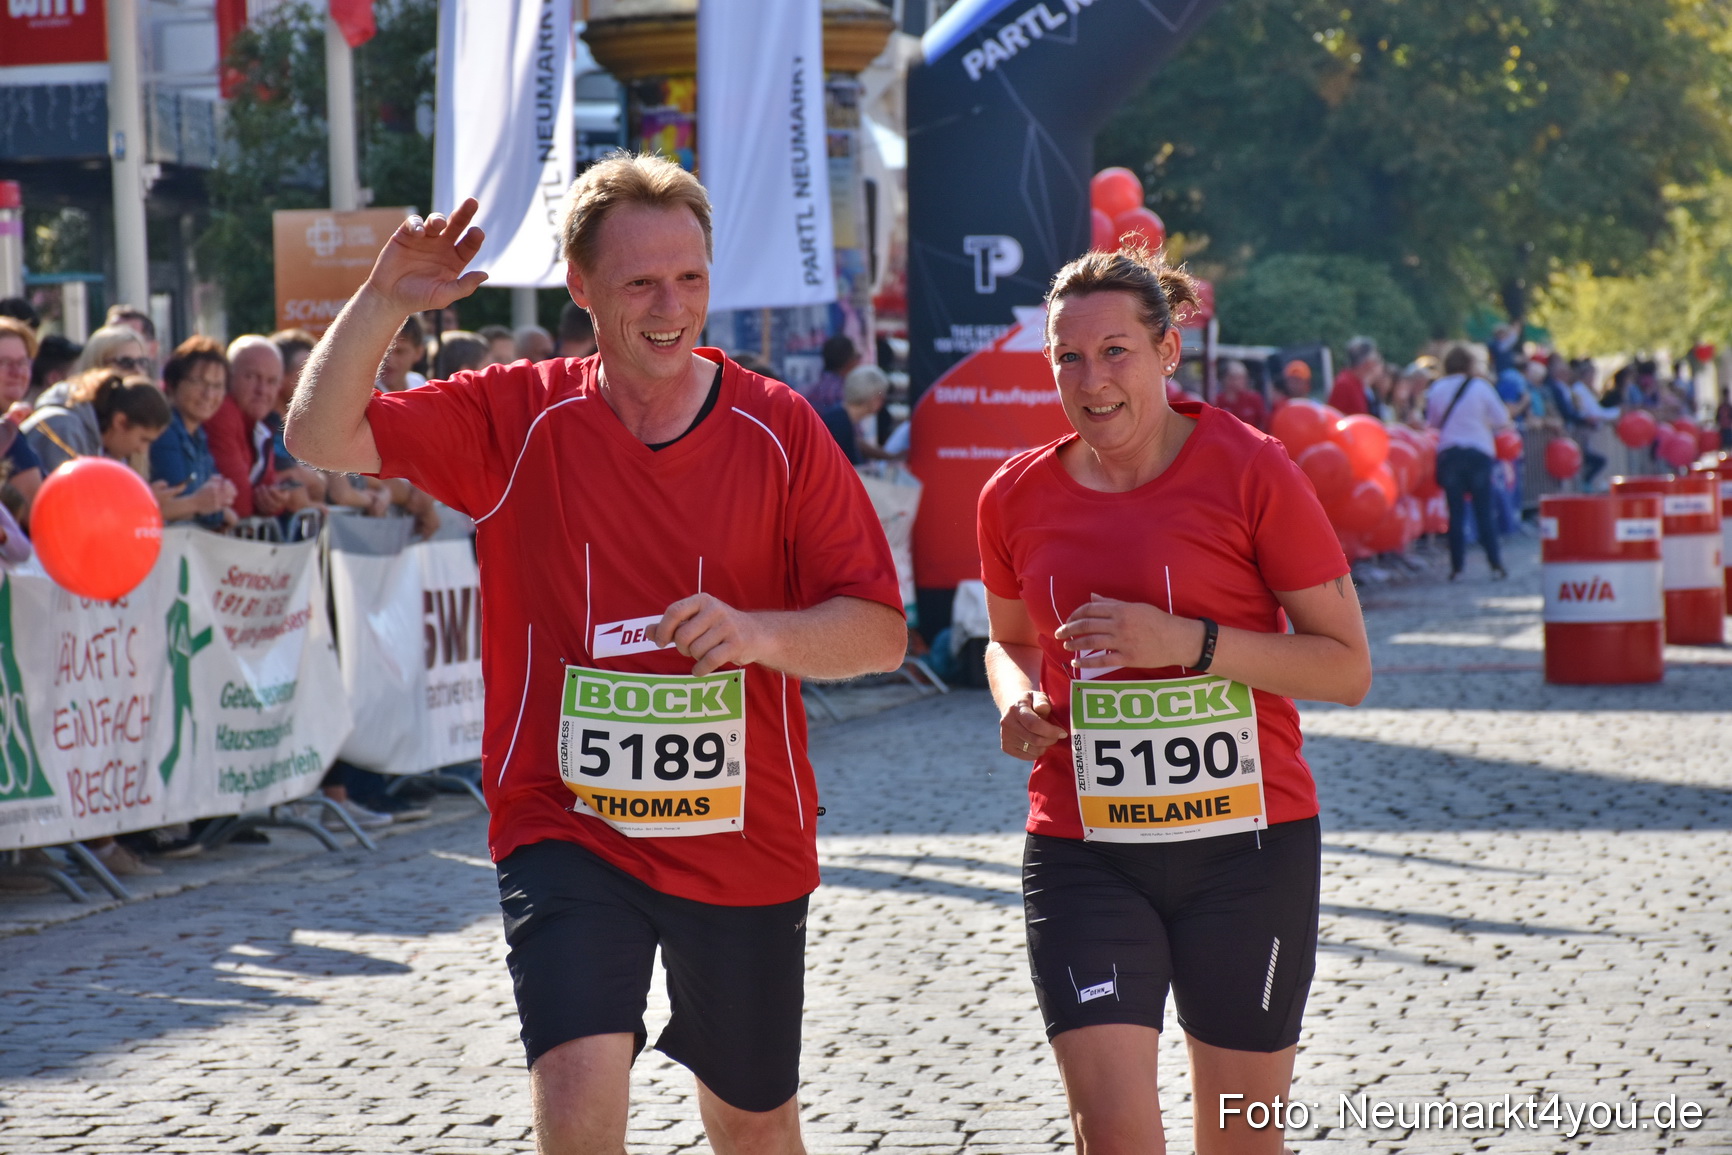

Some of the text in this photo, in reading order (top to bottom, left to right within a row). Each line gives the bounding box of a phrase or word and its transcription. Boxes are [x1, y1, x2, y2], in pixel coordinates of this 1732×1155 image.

[962, 3, 1067, 81] PARTL
[537, 0, 556, 164] NEUMARK
[796, 204, 823, 287] PARTL
[935, 386, 977, 404] BMW
[576, 676, 731, 718] BOCK
[1083, 680, 1240, 723] BOCK
[579, 729, 725, 781] 5189
[1094, 731, 1238, 786] 5190
[592, 794, 710, 817] THOMAS
[1108, 795, 1231, 823] MELANIE
